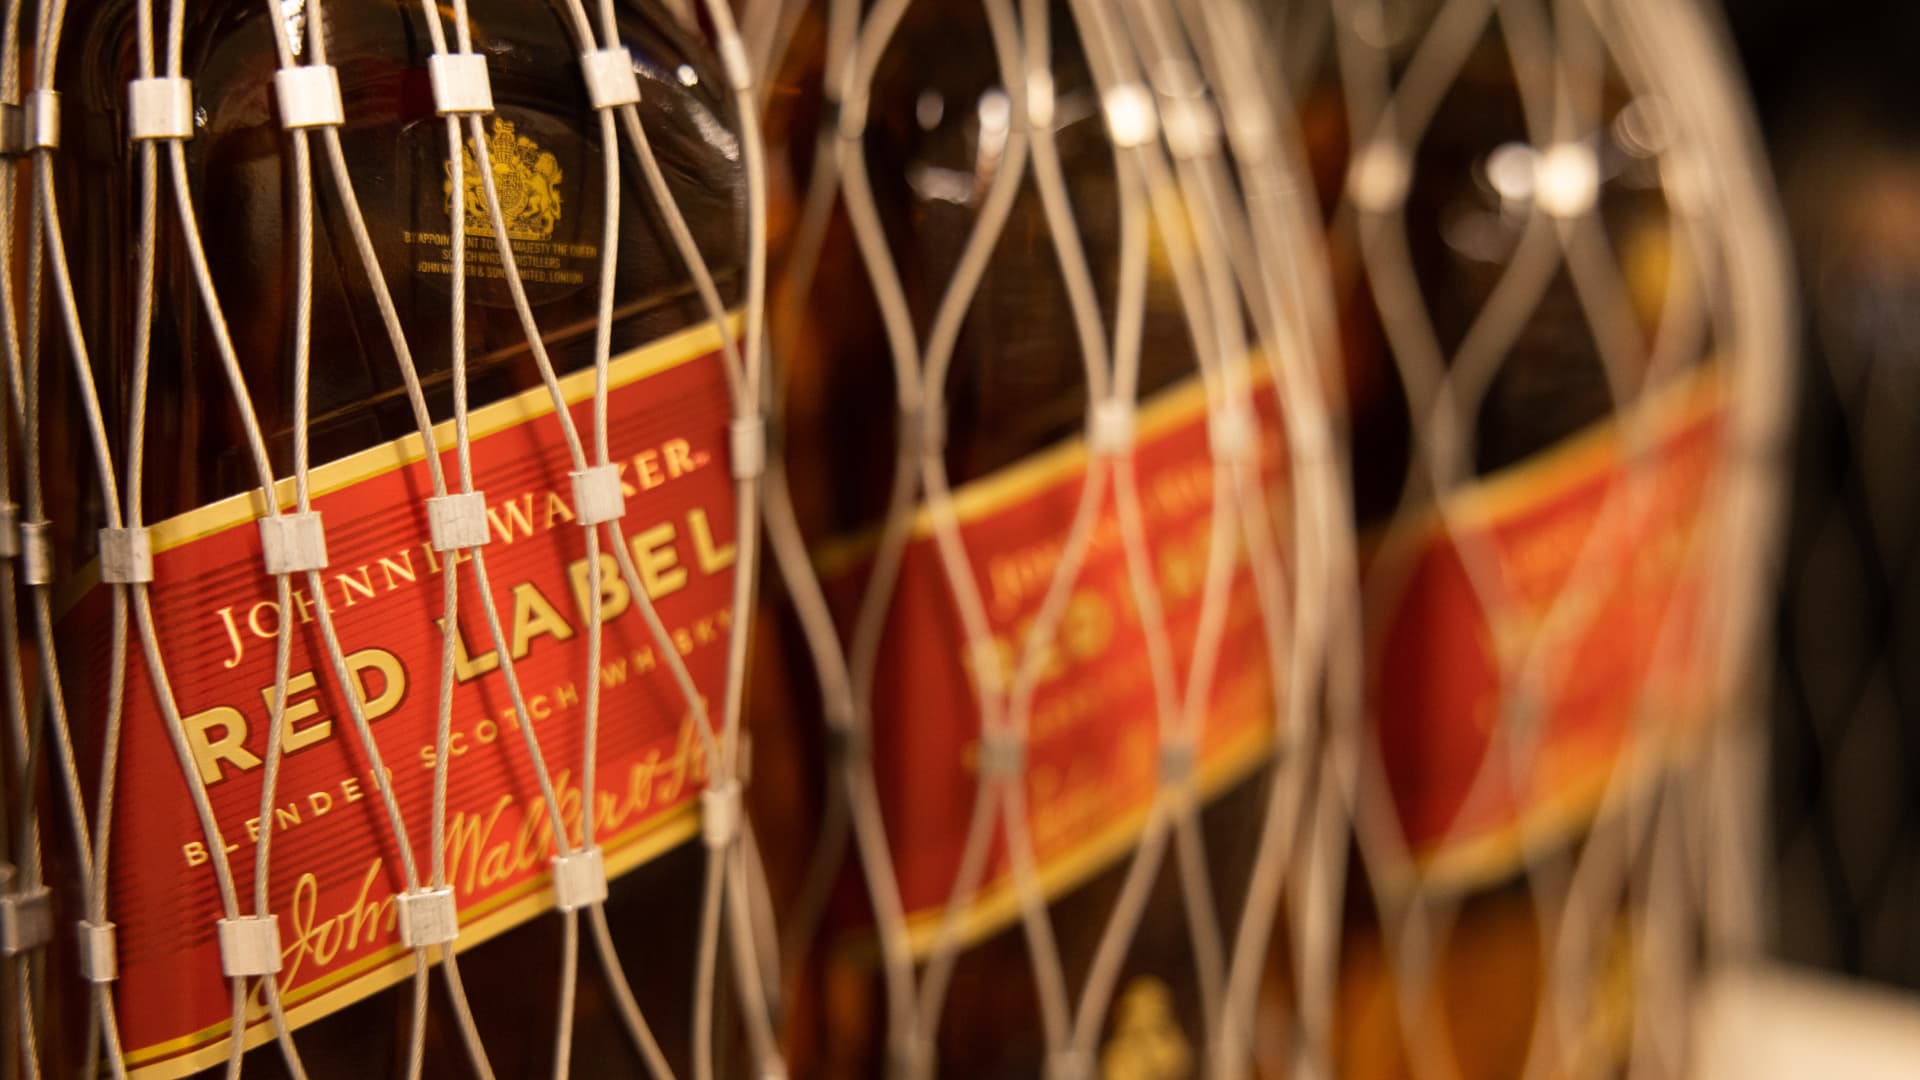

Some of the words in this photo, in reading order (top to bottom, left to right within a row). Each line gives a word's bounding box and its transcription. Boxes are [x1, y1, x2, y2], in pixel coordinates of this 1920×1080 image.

[180, 648, 406, 786] RED
[435, 507, 737, 681] LABEL
[217, 540, 472, 669] JOHNNI
[419, 682, 580, 769] SCOTCH
